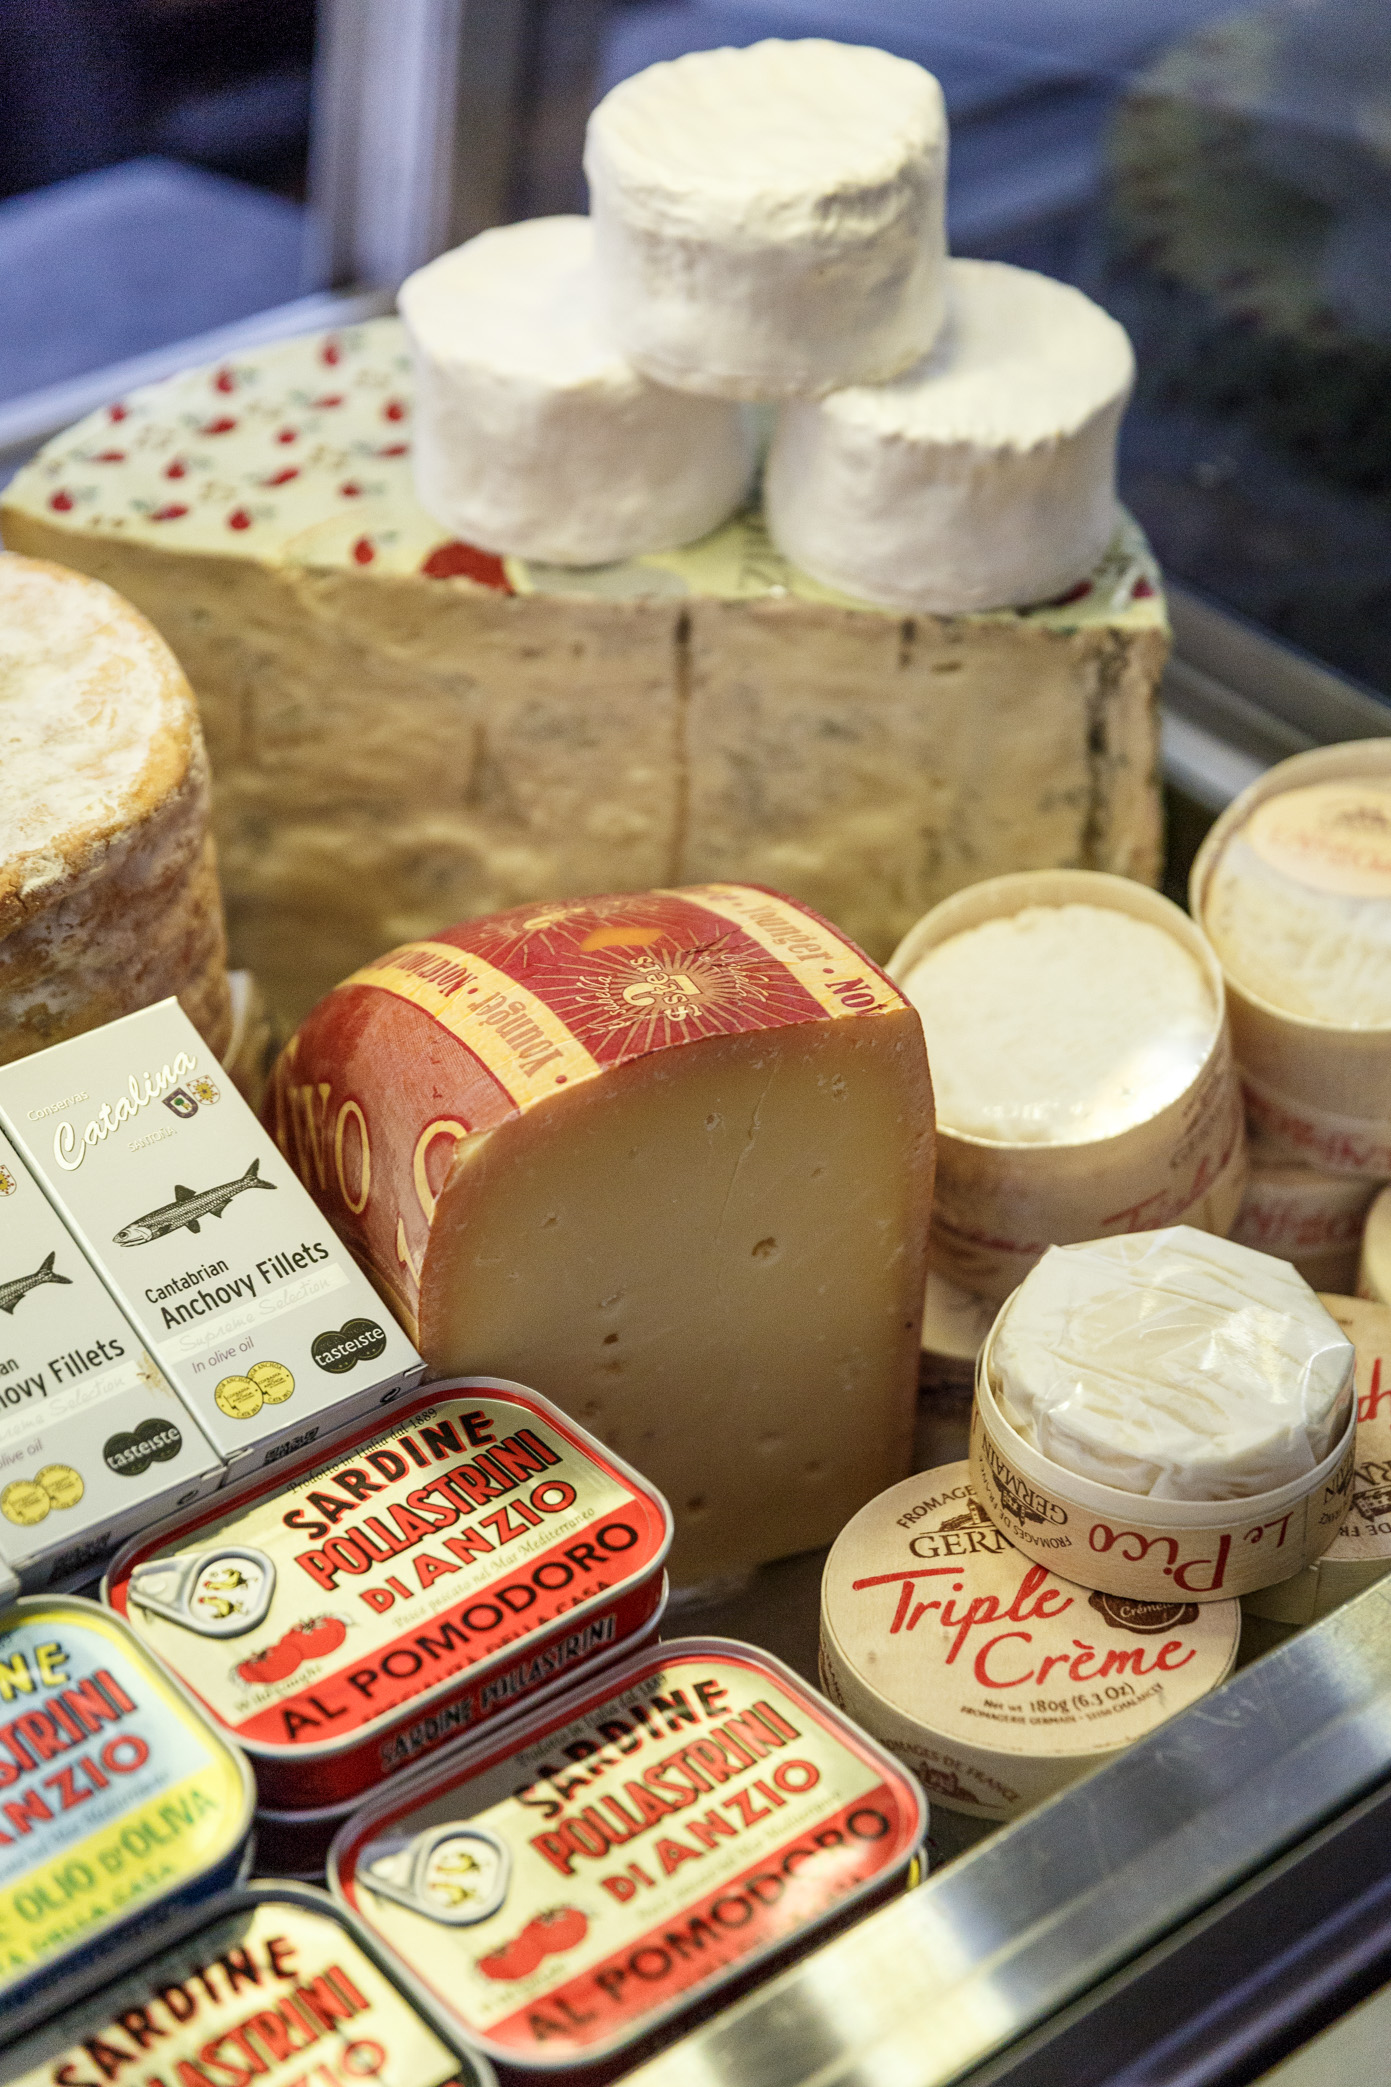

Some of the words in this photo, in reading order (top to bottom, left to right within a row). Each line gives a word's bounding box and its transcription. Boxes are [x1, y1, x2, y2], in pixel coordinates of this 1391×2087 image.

[738, 904, 834, 962] Younger
[467, 991, 564, 1079] Younger
[26, 1090, 90, 1122] Conservas
[53, 1051, 198, 1172] Catalina
[145, 1259, 230, 1304] Cantabrian
[160, 1273, 258, 1330] Anchovy
[255, 1242, 330, 1285] Fillets
[179, 1310, 256, 1352] Supreme
[258, 1275, 331, 1316] Selection
[47, 1338, 126, 1384] Fillets
[191, 1360, 208, 1374] In
[207, 1347, 238, 1368] olive
[238, 1335, 255, 1355] oil
[26, 1438, 43, 1457] oil
[283, 1410, 499, 1541] SARDINE
[286, 1461, 341, 1496] Prodotto
[340, 1452, 356, 1469] in
[356, 1434, 390, 1459] Italia
[389, 1423, 409, 1442] dal
[408, 1406, 439, 1430] 1889
[982, 1433, 1069, 1526] GERMAIN
[292, 1427, 564, 1592] POLLASTRINI
[517, 1507, 596, 1556] Mediterraneo
[896, 1484, 977, 1530] FROMAGE
[1012, 1524, 1073, 1550] FROMAGES
[1242, 1511, 1295, 1549] Le
[358, 1575, 415, 1615] DI
[411, 1479, 577, 1590] ANZIO
[1088, 1523, 1233, 1592] Pico
[280, 1695, 349, 1741] AL
[347, 1523, 639, 1698] POMODORO
[851, 1564, 1075, 1666] Triple
[479, 1613, 618, 1713] POLLASTRINI
[973, 1631, 1197, 1690] Crème
[959, 1705, 1027, 1725] FROMAGERIE
[1028, 1714, 1077, 1726] GERMAIN
[983, 1697, 1004, 1712] Net
[1007, 1702, 1023, 1713] wt
[1029, 1697, 1070, 1715] 180g
[1072, 1693, 1104, 1713] (6.3
[1104, 1681, 1136, 1702] Oz)
[511, 1678, 732, 1820] SARDINE
[529, 1700, 801, 1877] POLLASTRINI
[600, 1862, 657, 1904] DI
[653, 1759, 821, 1877] ANZIO
[12, 1856, 98, 1924] OLIO
[53, 1936, 298, 2087] SARDINE
[525, 1998, 599, 2042] AL
